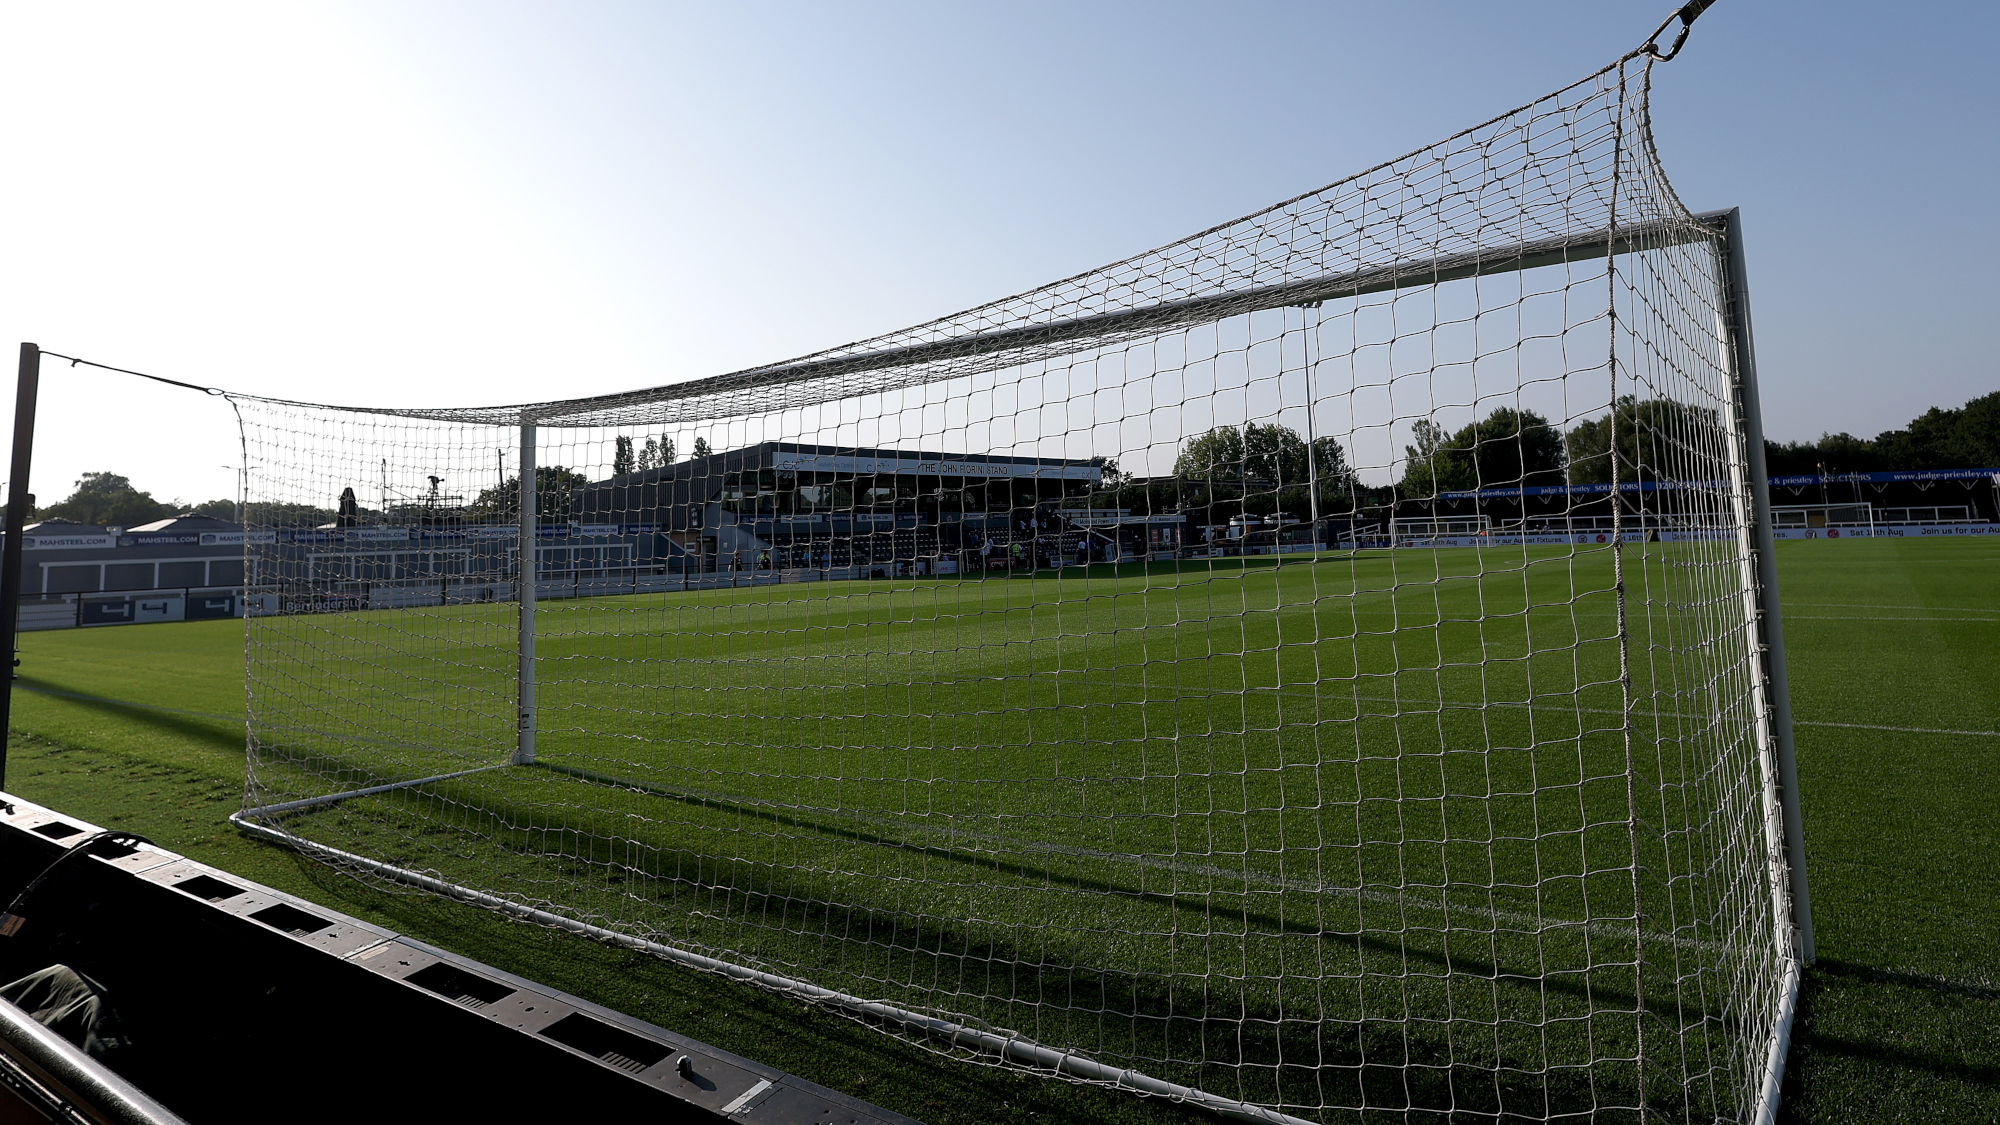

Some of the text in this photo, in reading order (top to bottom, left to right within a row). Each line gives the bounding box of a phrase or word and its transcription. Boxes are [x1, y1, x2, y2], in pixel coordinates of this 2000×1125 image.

[922, 464, 935, 472] THE
[960, 465, 984, 474] FORINI
[1894, 471, 2000, 480] www.judge-priestley.co
[1783, 477, 1813, 485] priestley
[1594, 483, 1639, 491] SOLICTORS
[39, 538, 106, 546] MAHSTEEL.COM
[138, 536, 197, 544] MAHSTEEL.COM
[285, 597, 346, 611] Berringers
